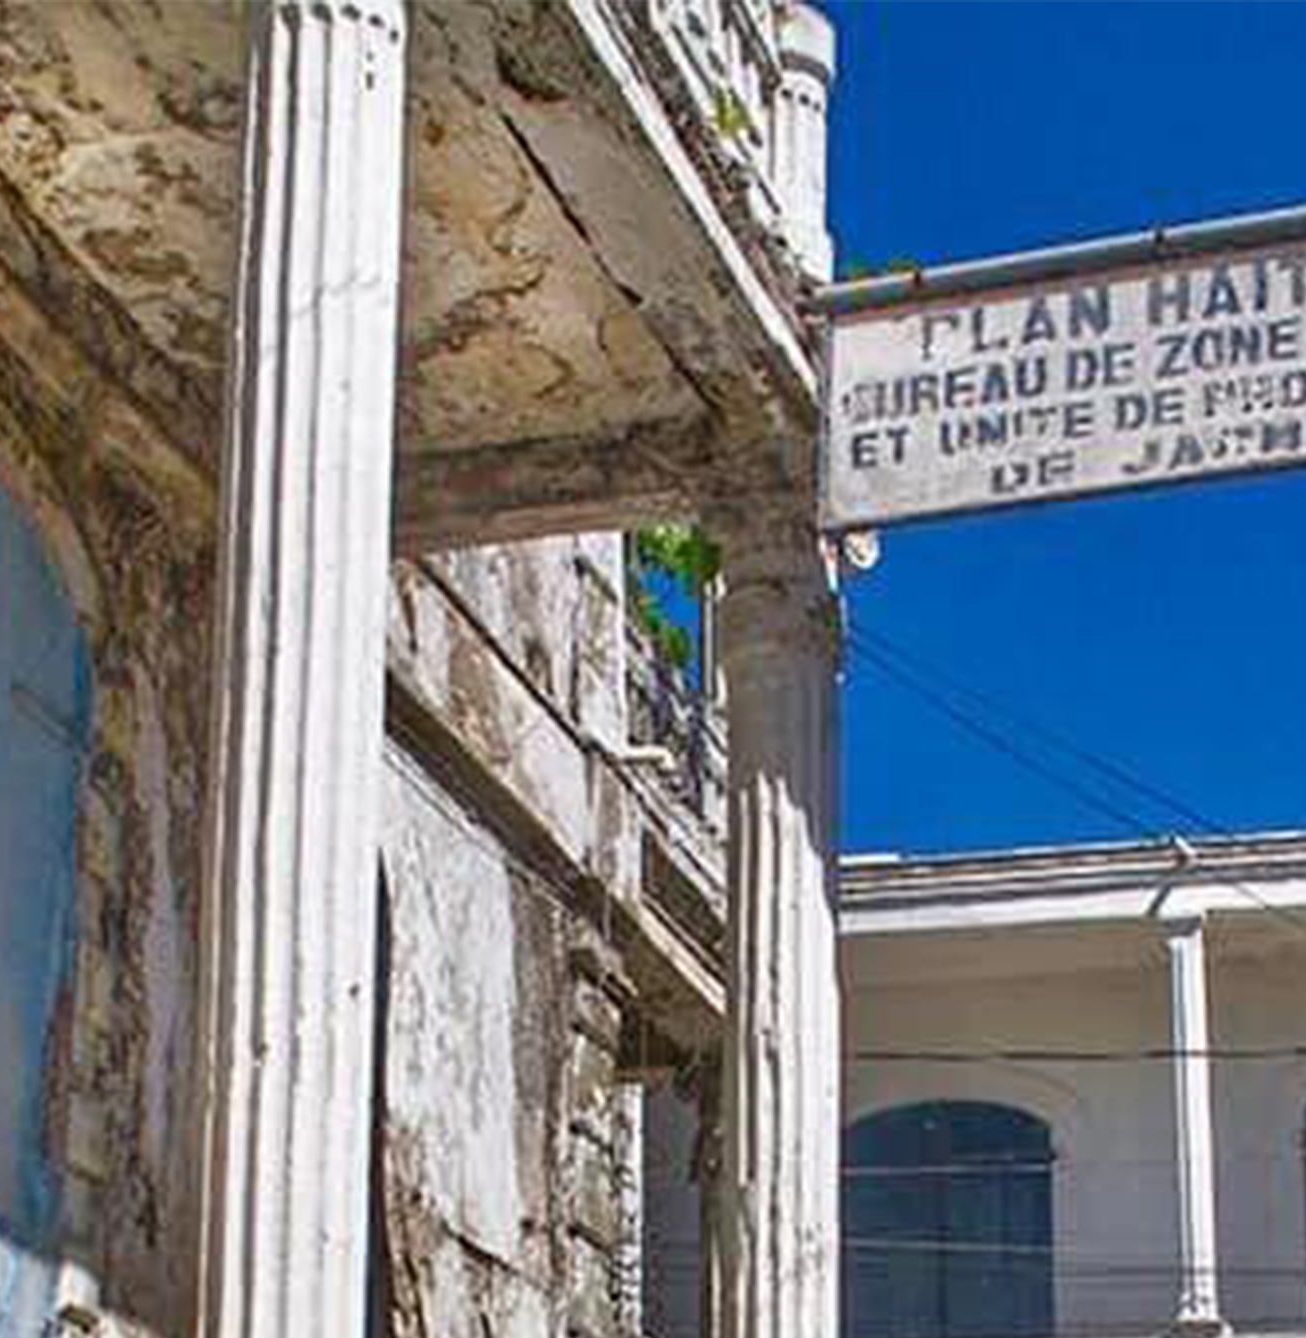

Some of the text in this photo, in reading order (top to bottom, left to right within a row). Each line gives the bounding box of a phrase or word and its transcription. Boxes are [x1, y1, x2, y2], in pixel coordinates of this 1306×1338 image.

[919, 287, 1111, 361] PLAN
[1066, 342, 1136, 393] DE
[1155, 315, 1298, 379] ZONE
[849, 425, 909, 471] ET
[939, 401, 1094, 456] UNITE
[1114, 386, 1186, 431] DE
[991, 450, 1076, 494] DE
